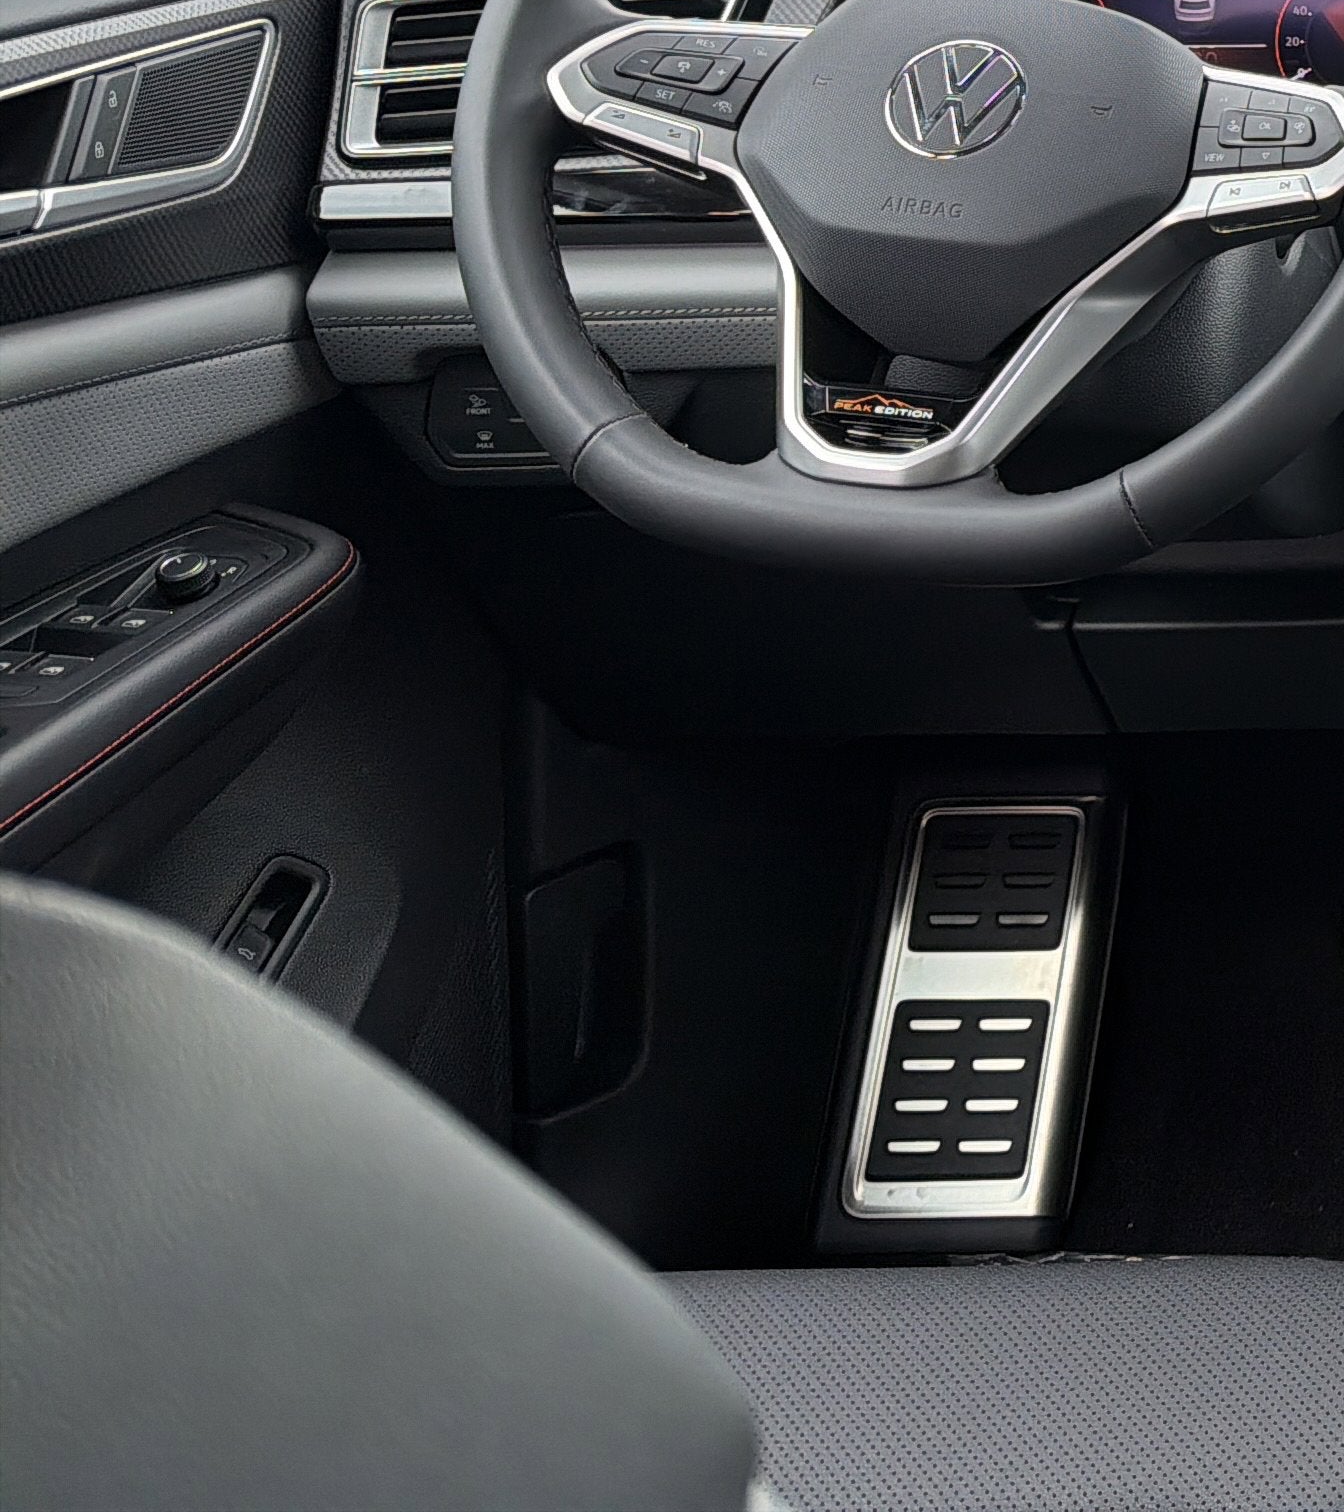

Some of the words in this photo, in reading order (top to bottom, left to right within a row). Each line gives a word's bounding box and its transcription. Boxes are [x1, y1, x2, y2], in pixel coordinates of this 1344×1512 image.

[1292, 5, 1308, 16] 40
[695, 38, 716, 49] RES
[1285, 36, 1300, 47] 20
[655, 88, 677, 101] SET
[1203, 153, 1225, 163] VIEW
[880, 197, 963, 218] AIRBAG
[466, 407, 491, 416] FRONT
[834, 401, 872, 413] PEAK
[873, 405, 934, 420] EDITION
